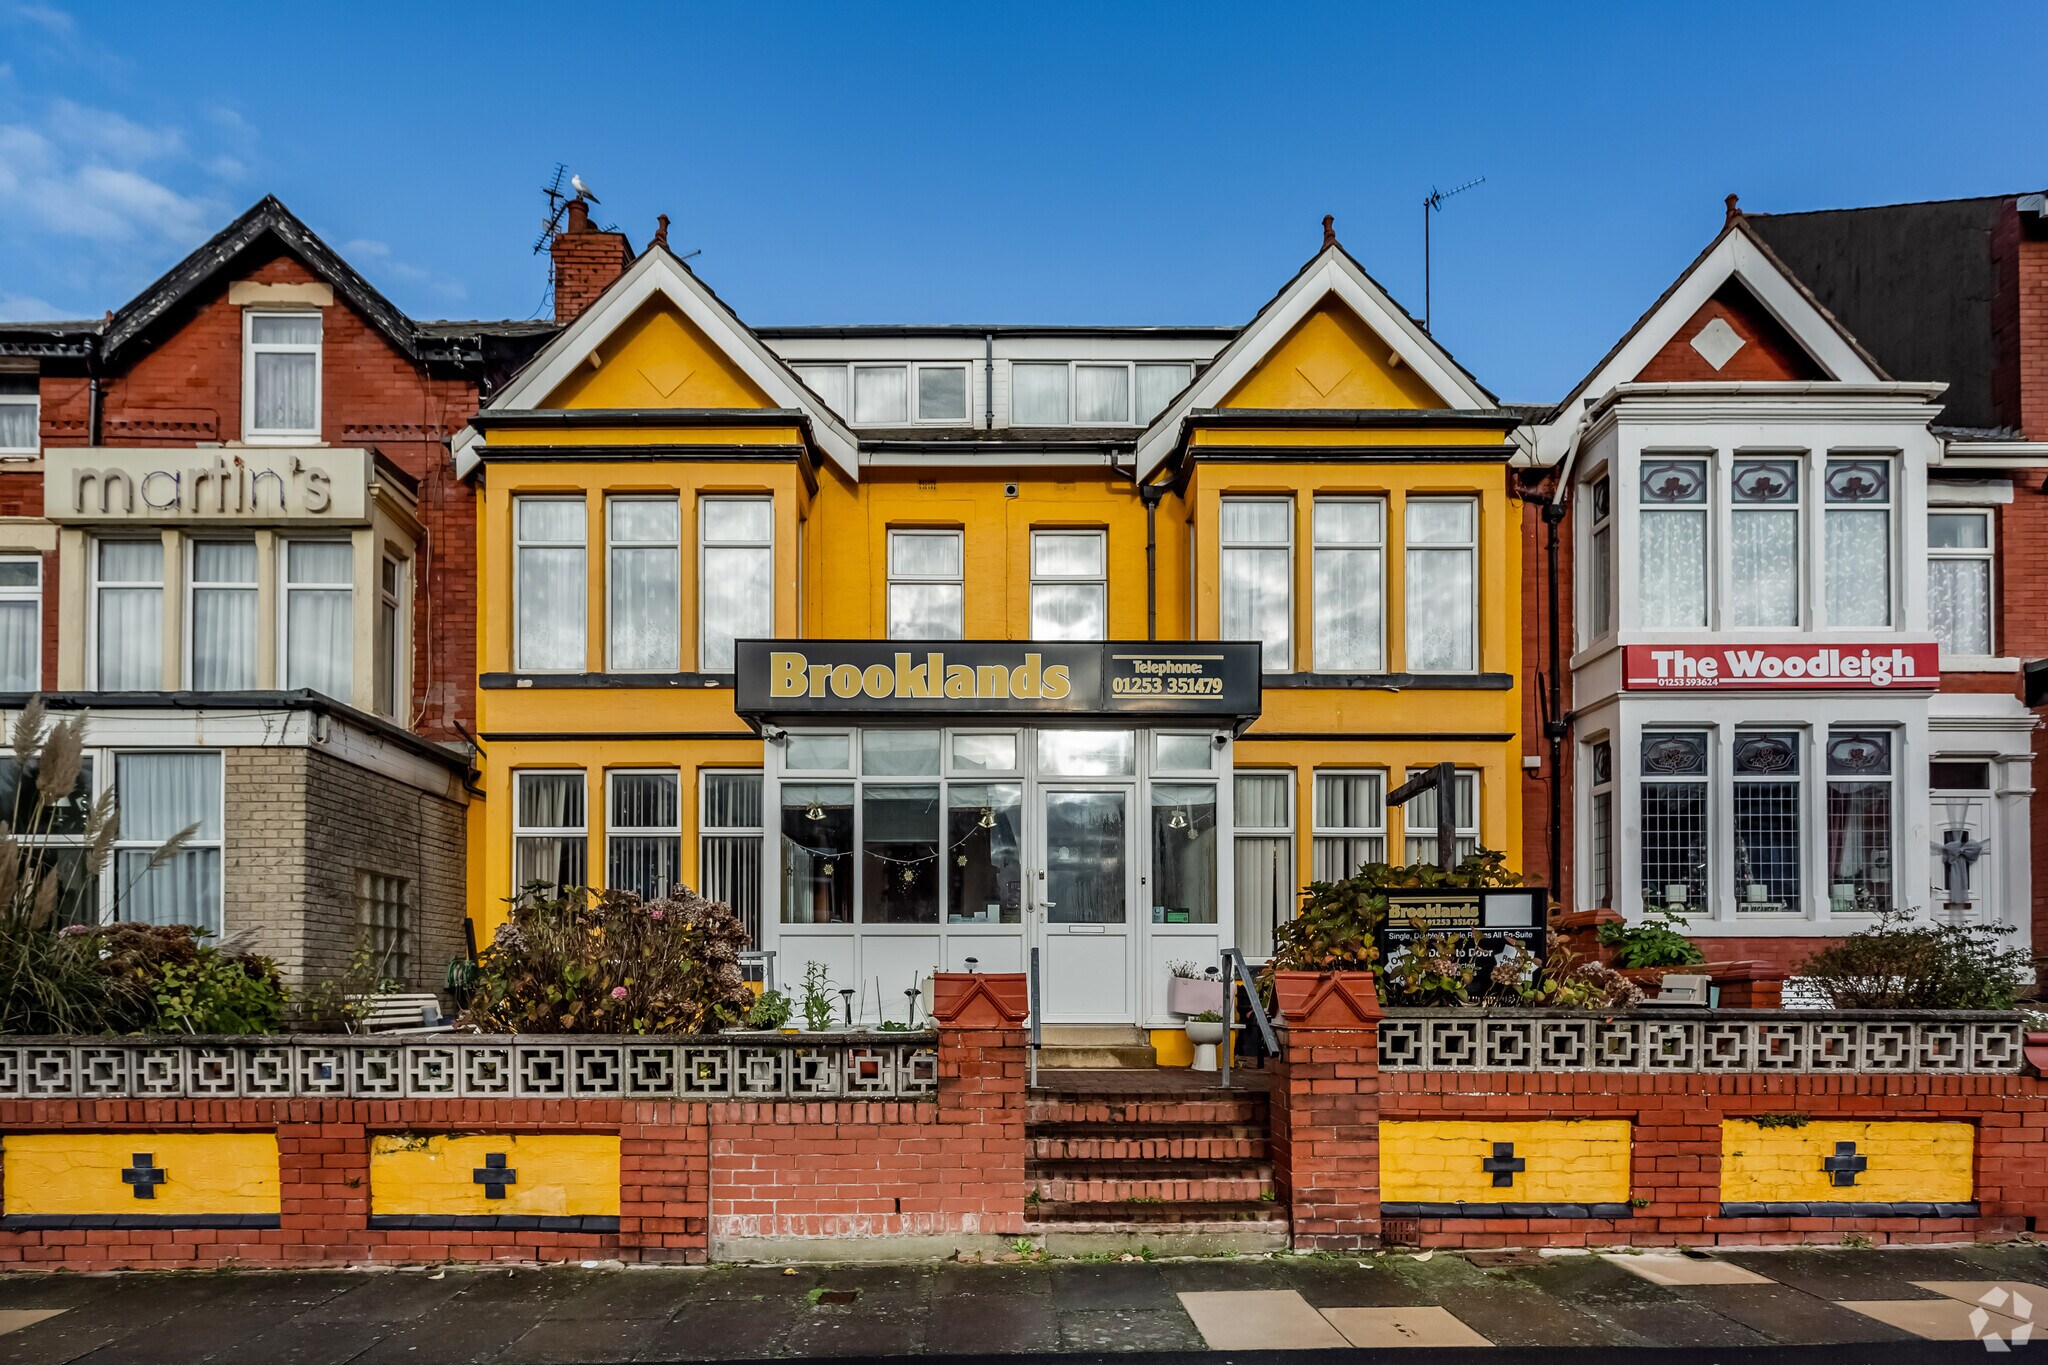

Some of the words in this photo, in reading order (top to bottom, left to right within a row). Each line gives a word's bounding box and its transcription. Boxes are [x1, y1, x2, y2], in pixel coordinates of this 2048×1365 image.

[72, 455, 332, 514] martin's
[1132, 660, 1203, 676] Telephone:
[1651, 650, 1719, 678] The
[1723, 649, 1915, 686] Woodleigh
[769, 651, 1072, 700] Brooklands
[1658, 678, 1684, 687] 01253
[1685, 678, 1719, 687] 593624
[1112, 677, 1163, 694] 01253
[1166, 677, 1223, 694] 351479
[1388, 903, 1479, 918] Brooklands
[1452, 918, 1480, 926] 351479
[1388, 932, 1413, 942] Single,
[1493, 931, 1502, 939] All
[1455, 948, 1466, 957] to
